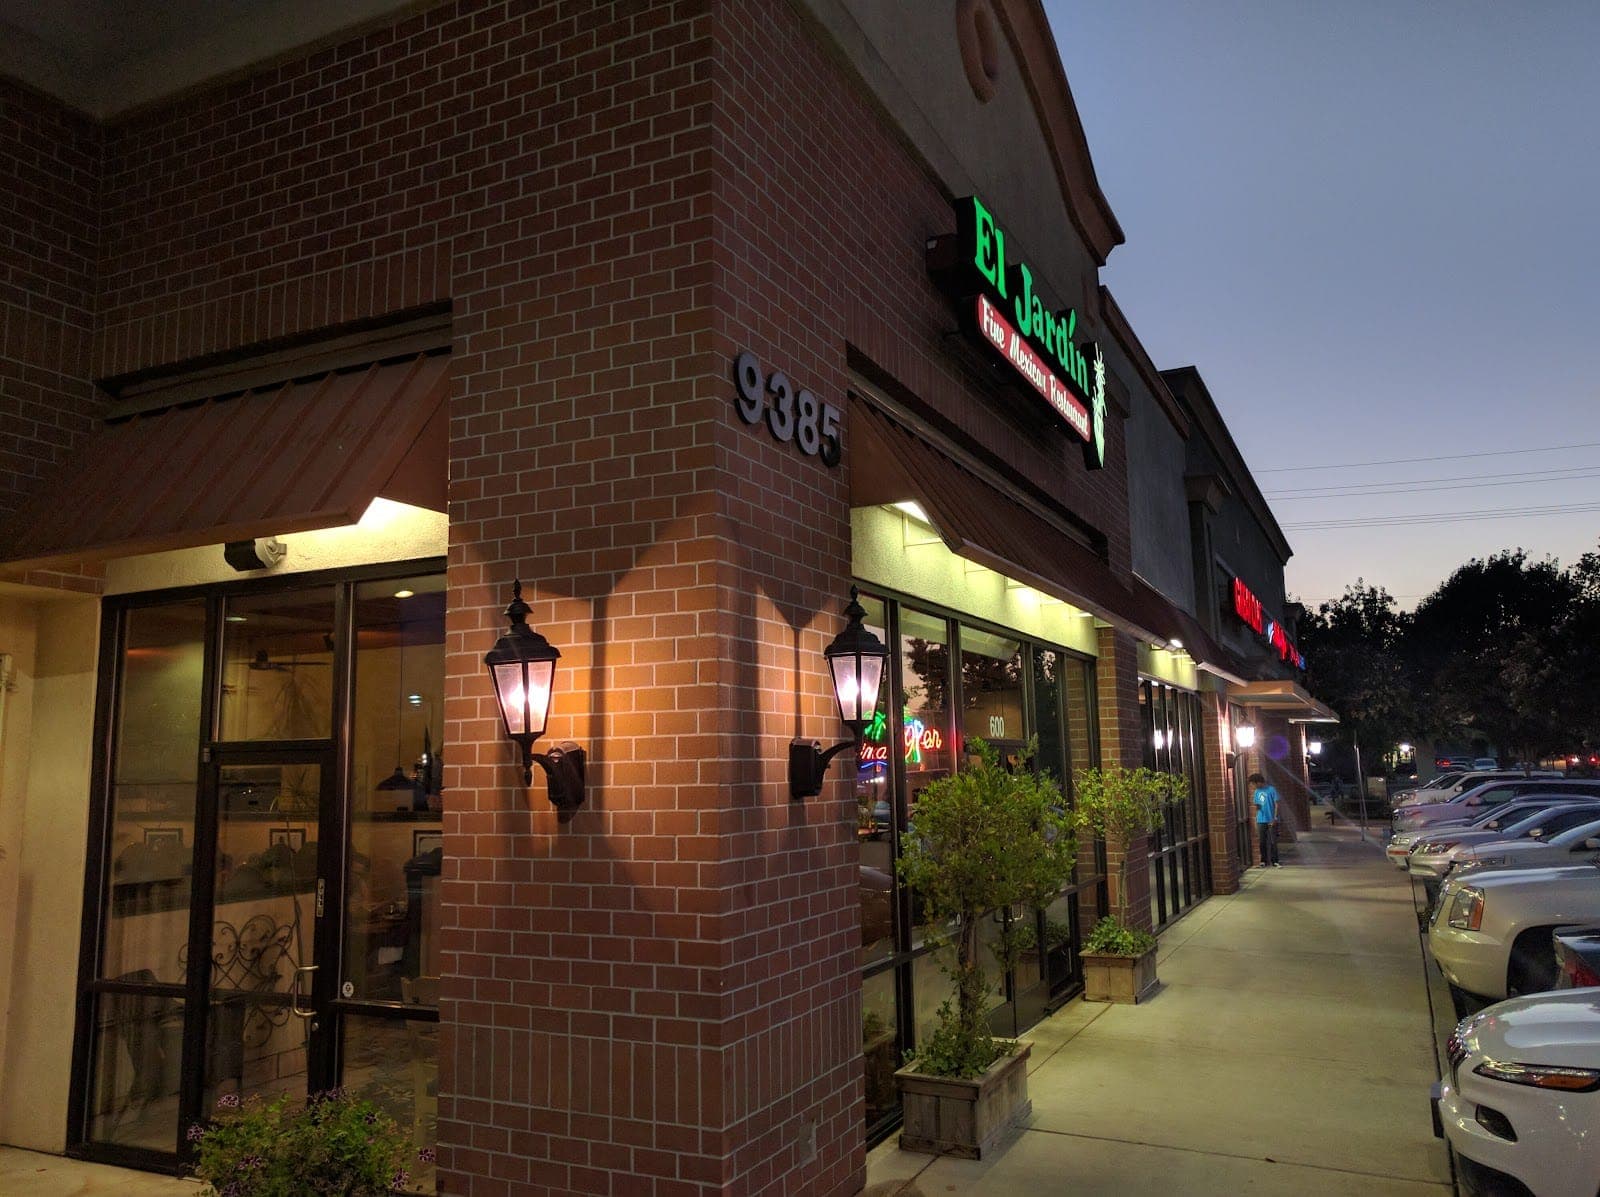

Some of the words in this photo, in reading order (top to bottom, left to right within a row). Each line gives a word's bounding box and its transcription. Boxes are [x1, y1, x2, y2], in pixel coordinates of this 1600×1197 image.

[974, 196, 1007, 299] El
[1015, 262, 1089, 397] Jardín
[734, 351, 842, 468] 9385
[982, 297, 1005, 349] Fine
[1009, 335, 1047, 393] Mexican
[1049, 375, 1089, 436] Restaurant
[989, 715, 1005, 738] 600
